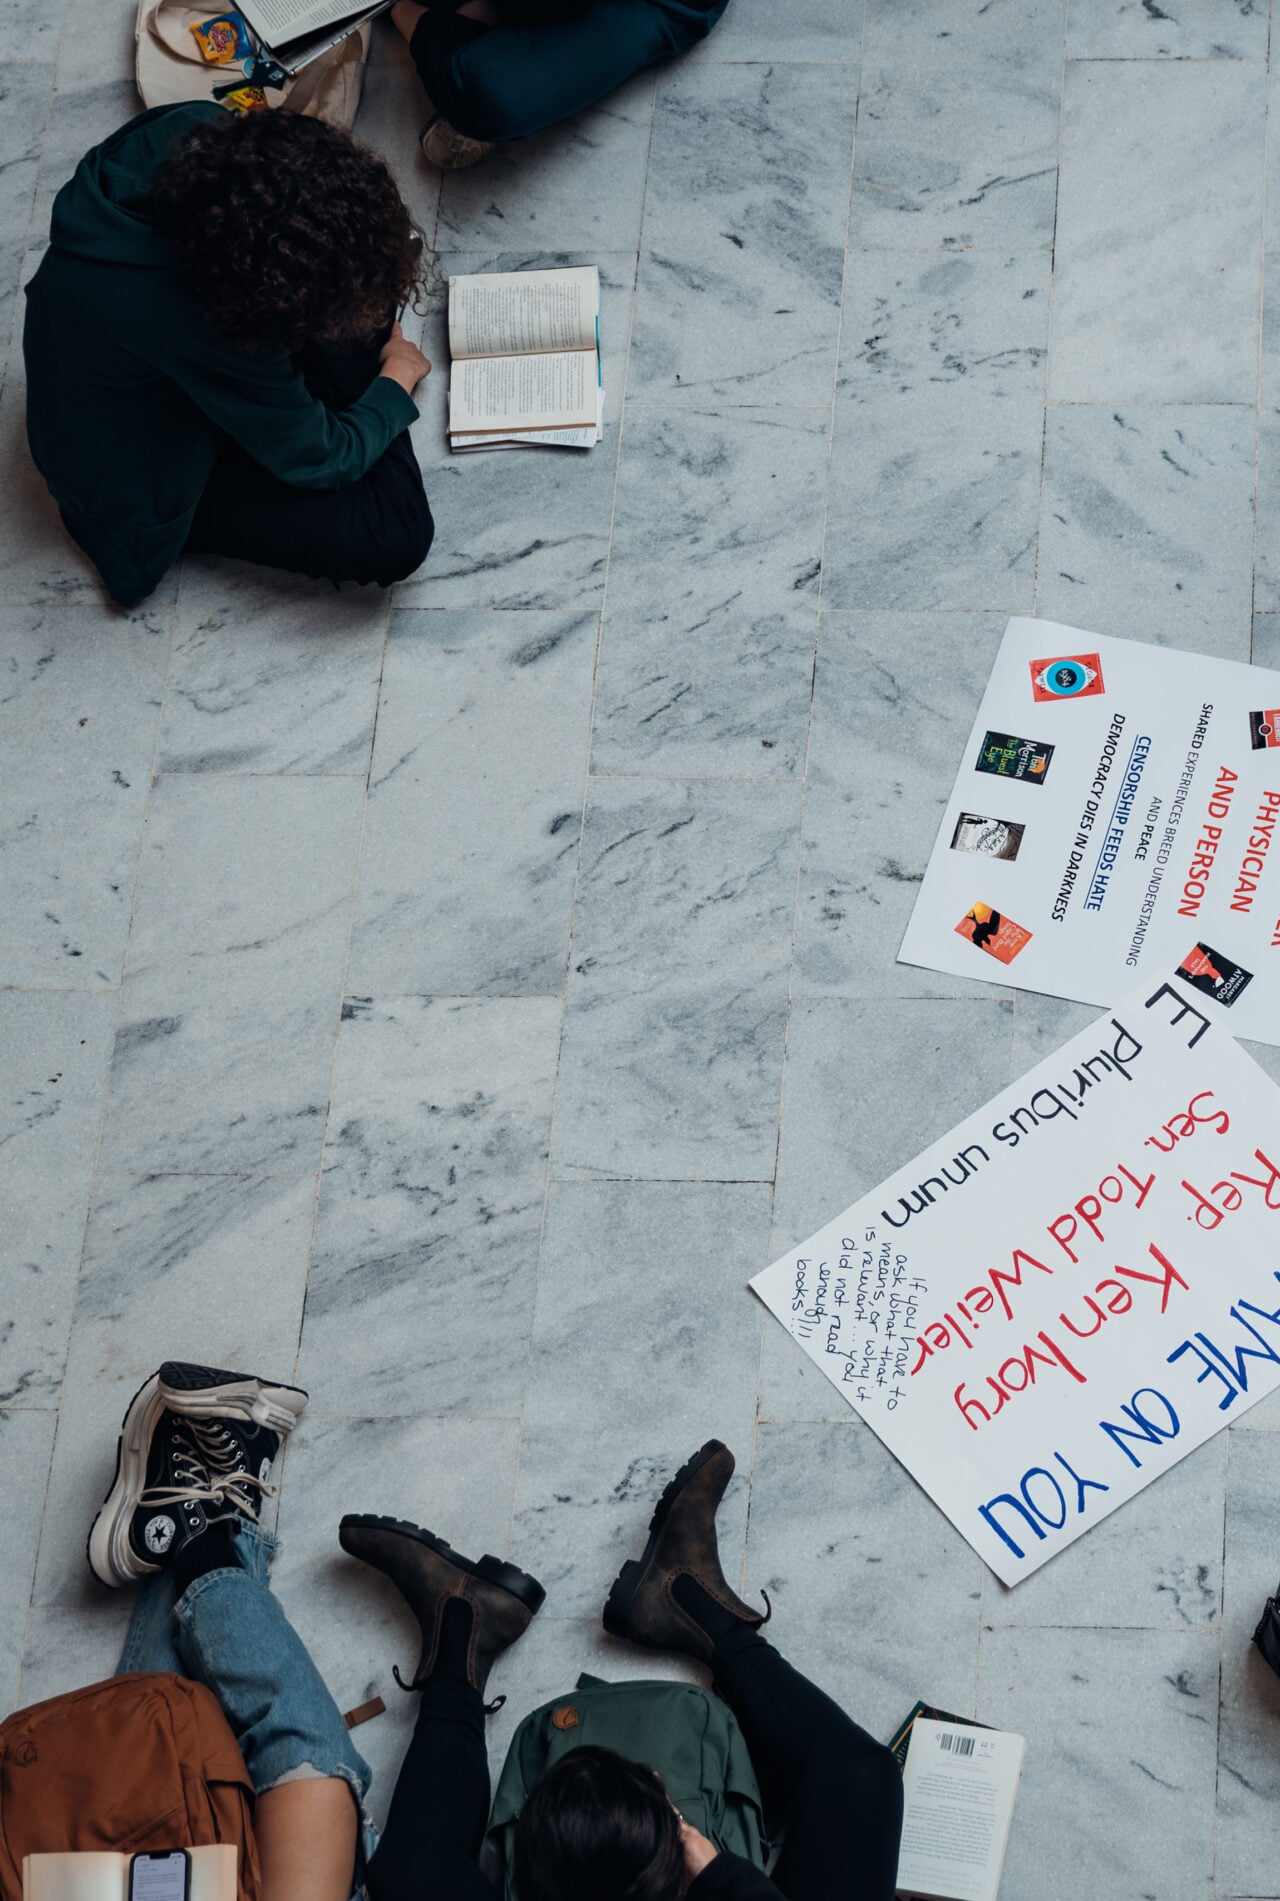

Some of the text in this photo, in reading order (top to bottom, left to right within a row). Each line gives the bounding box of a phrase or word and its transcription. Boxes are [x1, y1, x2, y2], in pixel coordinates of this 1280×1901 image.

[1057, 668, 1073, 687] 1984
[982, 743, 1003, 765] Eye
[1010, 739, 1037, 780] Morrison
[1050, 713, 1126, 923] DEMOCRACY DIES IN DARKNESS
[1085, 734, 1152, 913] CENSORSHIP FEEDS HATE
[1124, 703, 1214, 968] SHARED EXPERIENCES BREED UNDERSTANDING
[1133, 796, 1163, 862] AND PEACE
[1177, 766, 1238, 918] AND PERSON
[1214, 966, 1242, 1001] ATWOOD
[1224, 974, 1245, 1001] MARGARET
[879, 982, 1212, 1228] E pluribus unum
[864, 1225, 876, 1241] is
[910, 1090, 1229, 1376] Sen. Todd Weiler
[804, 1261, 828, 1325] enough
[825, 1237, 855, 1354] did not read
[852, 1242, 892, 1403] means, or why it
[878, 1254, 908, 1387] ask what that
[1058, 1243, 1189, 1338] Ken
[838, 1349, 859, 1384] you
[886, 1277, 928, 1411] If you have to
[952, 1330, 1086, 1431] Ivory
[1097, 1387, 1180, 1469] ON
[976, 1450, 1110, 1559] YOU
